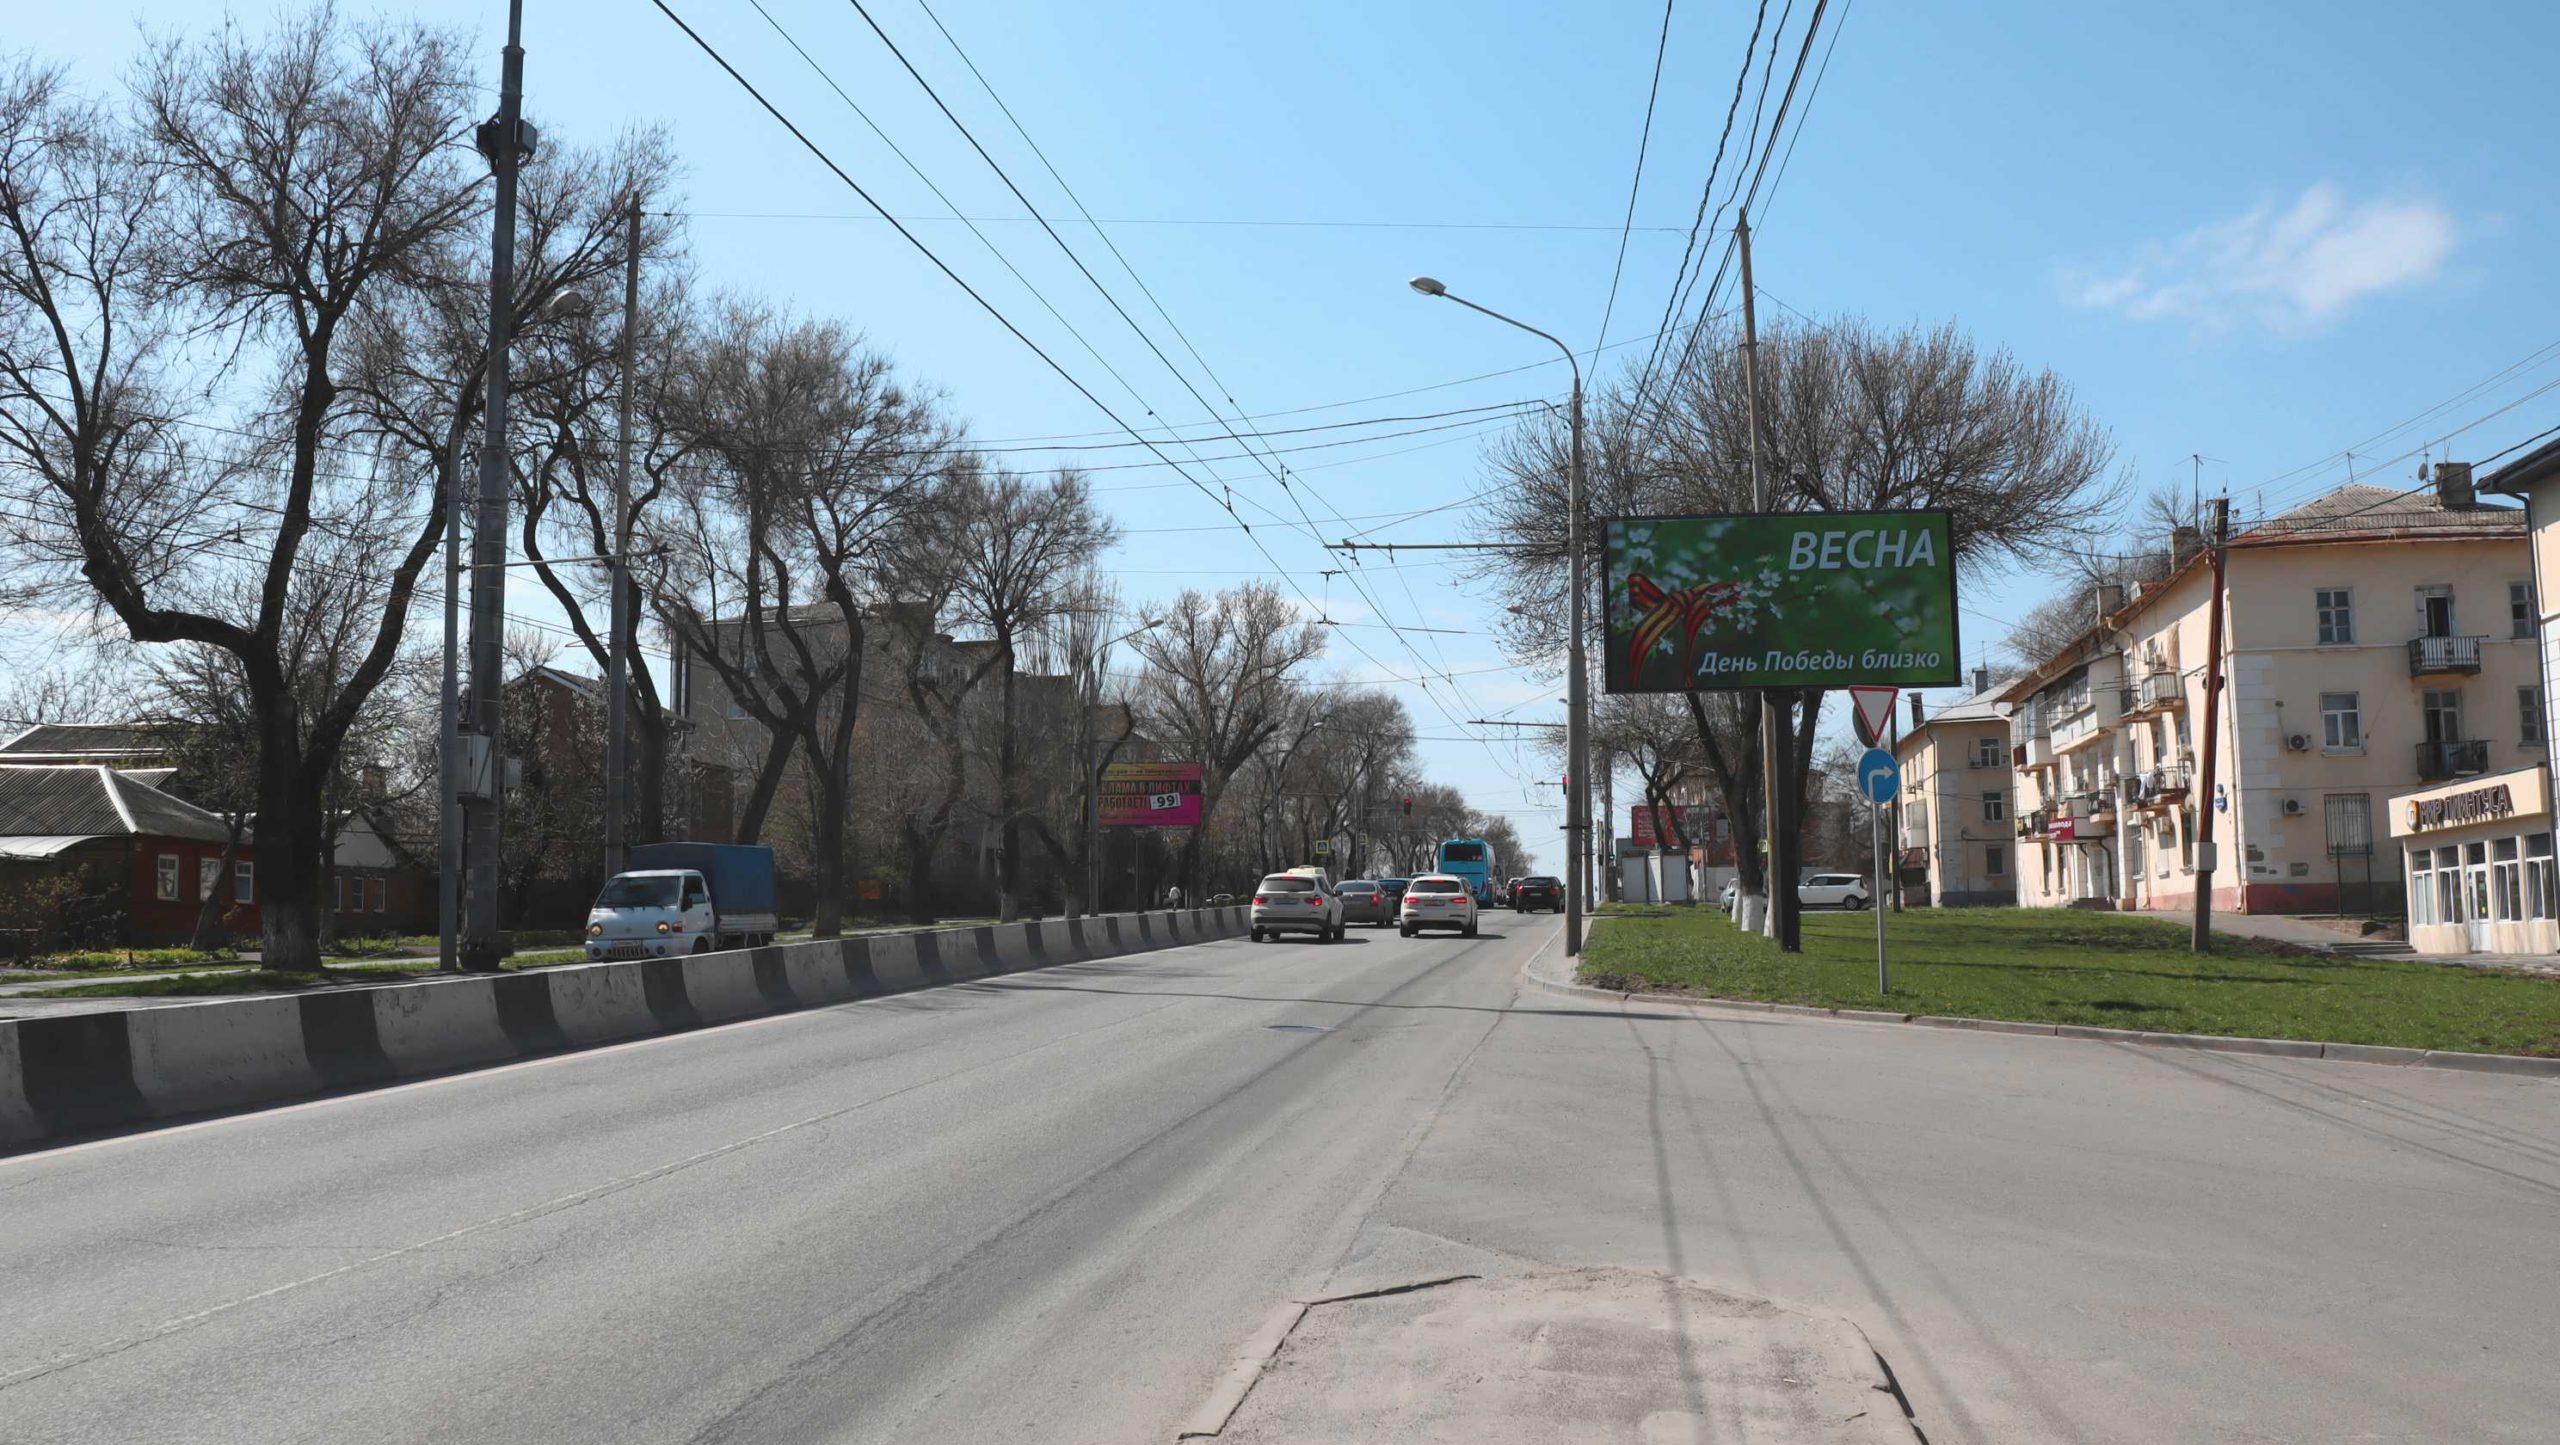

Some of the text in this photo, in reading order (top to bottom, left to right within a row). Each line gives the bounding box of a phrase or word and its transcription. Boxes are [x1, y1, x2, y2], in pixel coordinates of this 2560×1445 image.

[1788, 529, 1936, 571] ВЕСНА
[1697, 649, 1940, 676] День Победы близко
[2420, 798, 2444, 825] МИР
